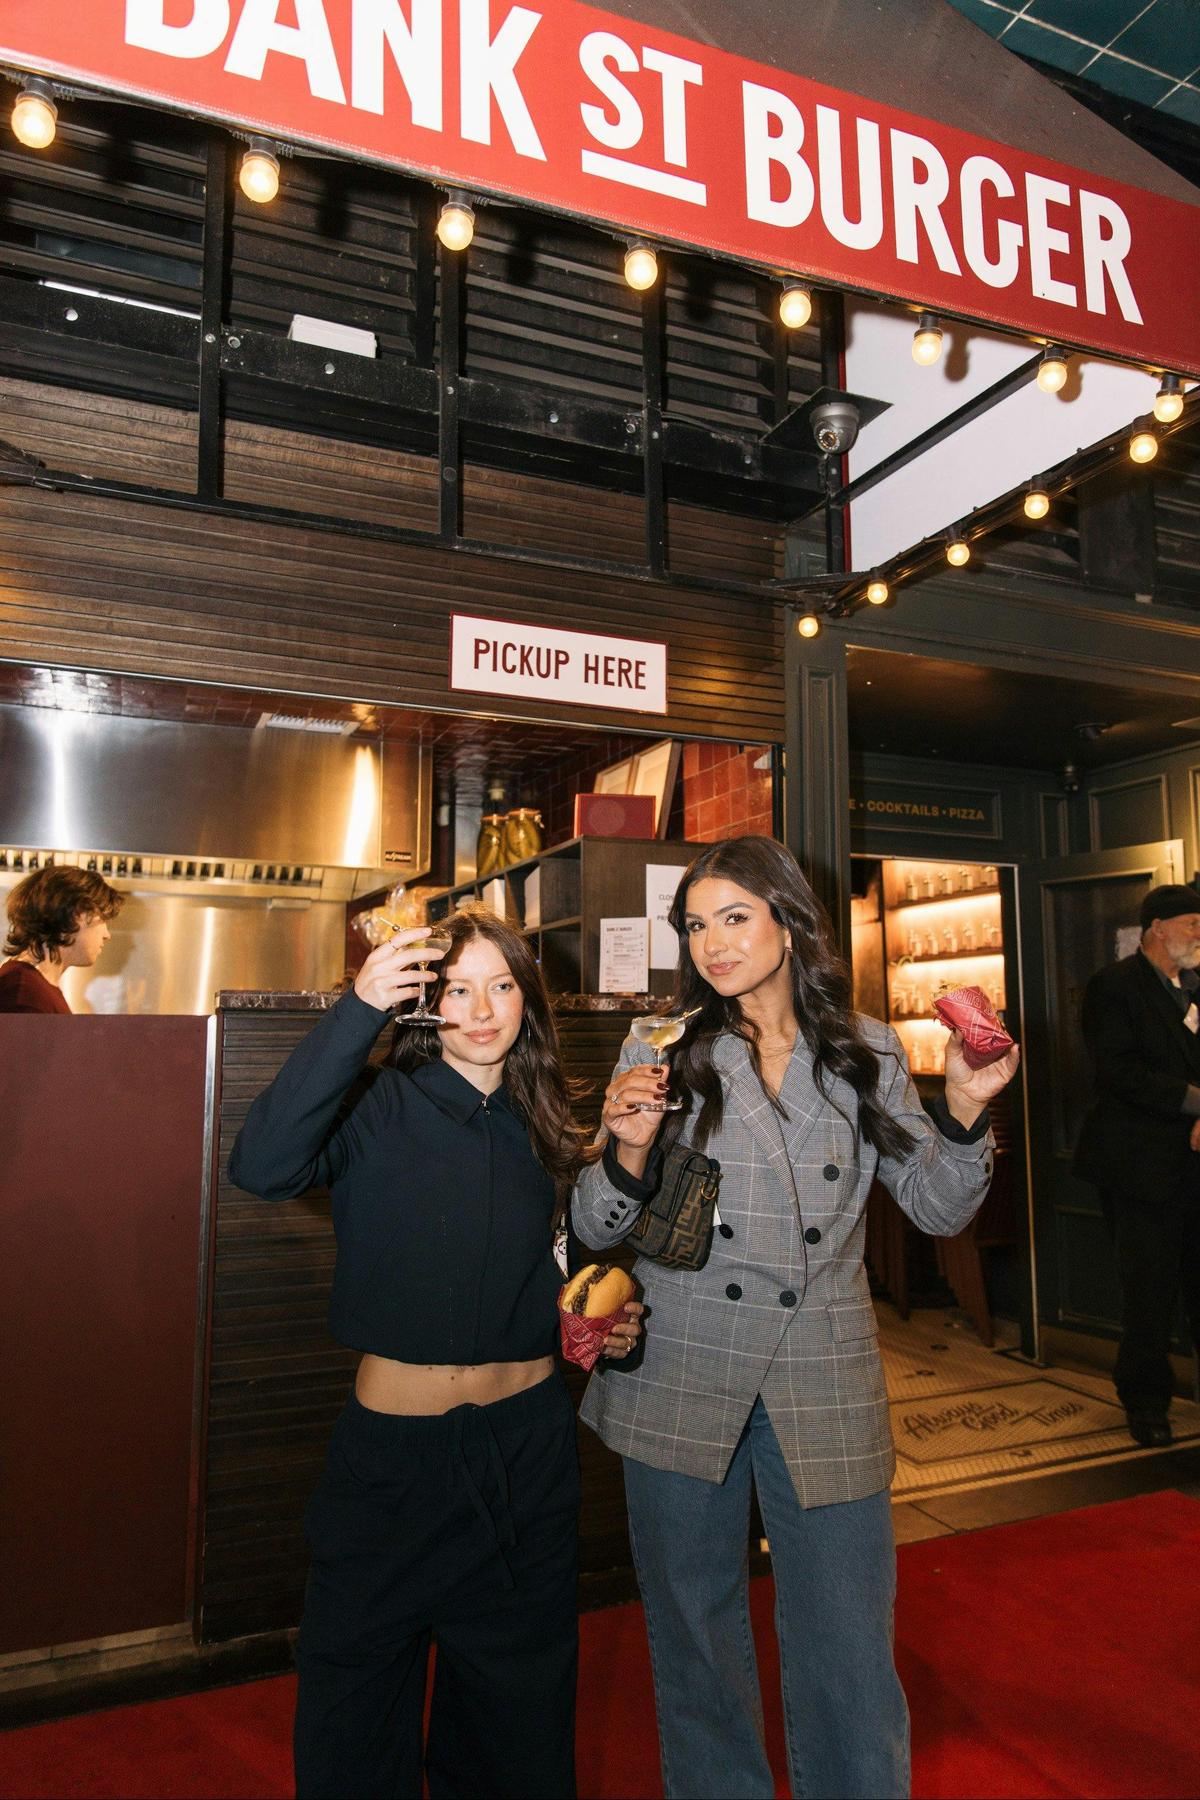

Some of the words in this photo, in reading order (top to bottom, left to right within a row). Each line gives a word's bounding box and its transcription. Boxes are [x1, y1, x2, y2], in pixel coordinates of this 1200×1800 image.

[579, 30, 704, 168] ST
[741, 79, 1145, 327] BURGER
[473, 637, 570, 680] PICKUP
[584, 653, 646, 690] HERE
[866, 800, 939, 817] COCKTAILS
[949, 807, 985, 820] PIZZA
